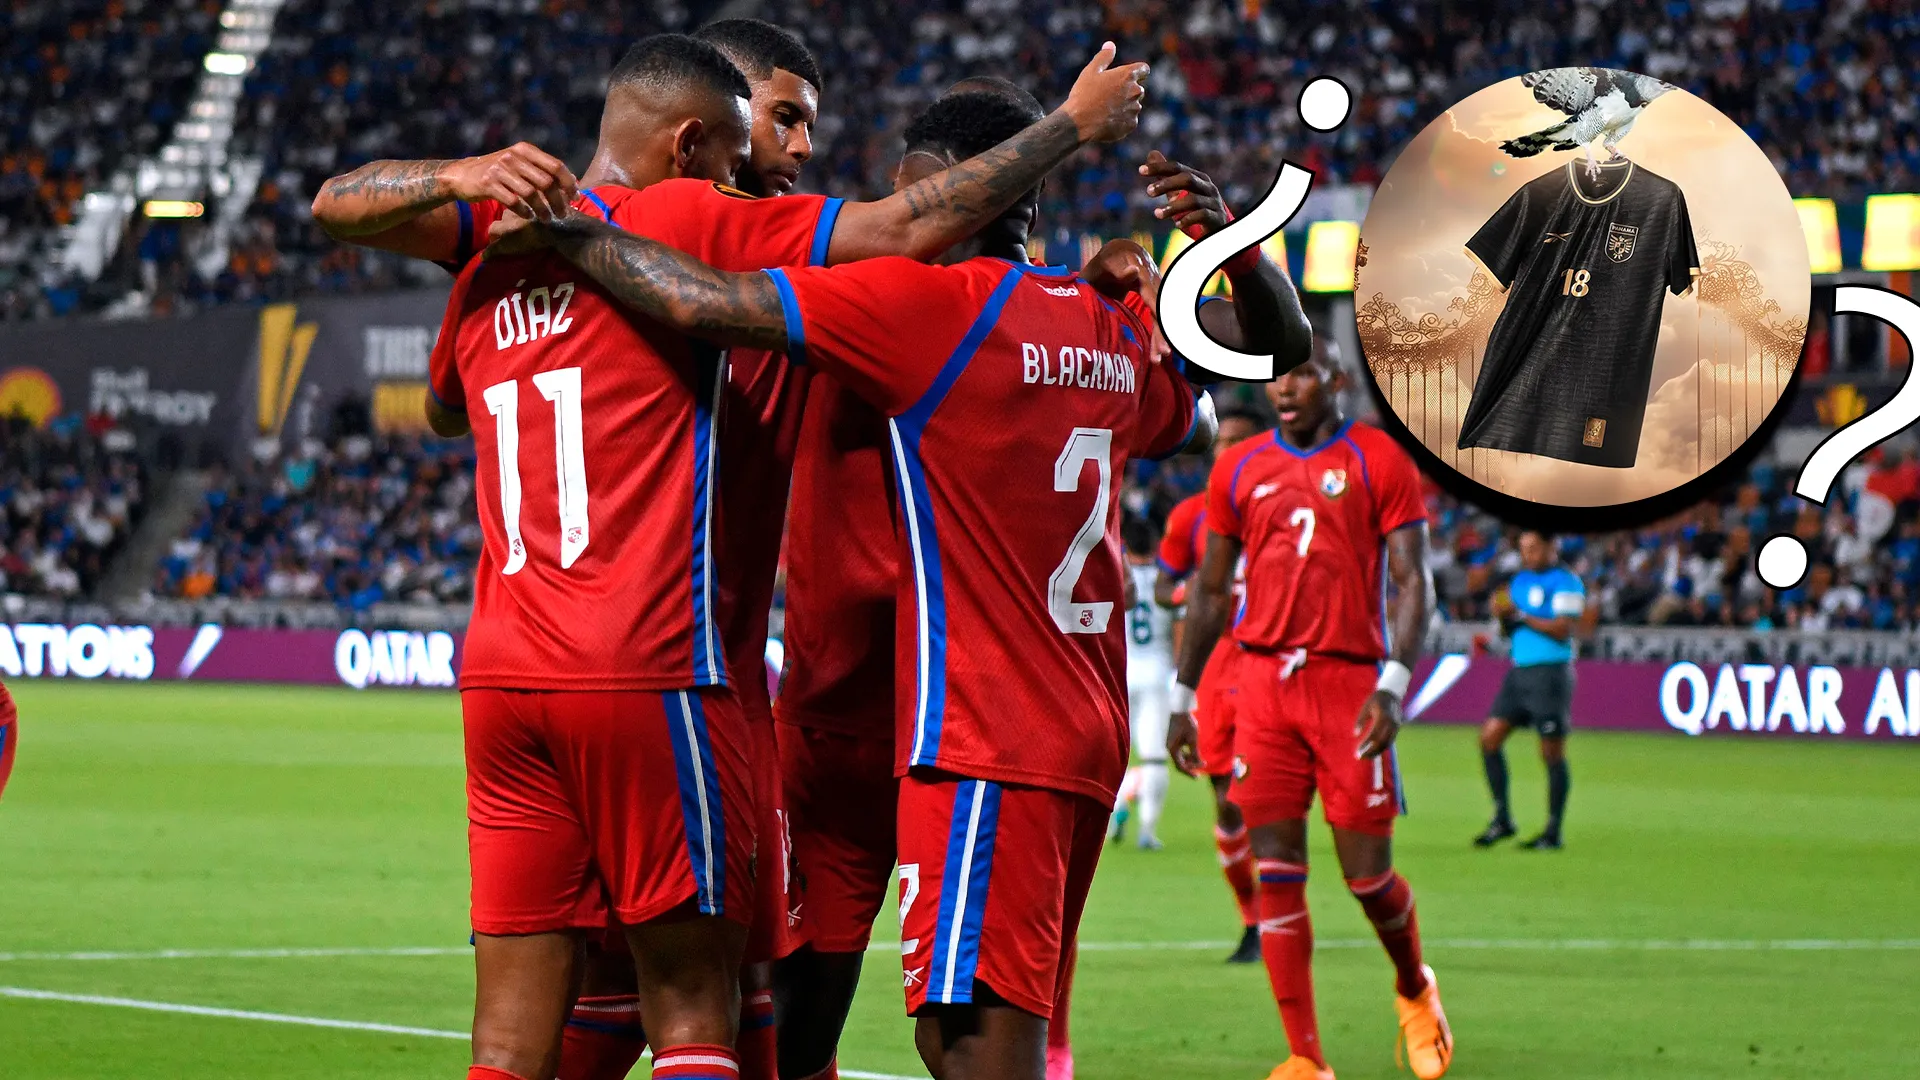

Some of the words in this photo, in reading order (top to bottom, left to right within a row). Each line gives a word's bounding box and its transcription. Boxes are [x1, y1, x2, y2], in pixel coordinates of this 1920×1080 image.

[495, 279, 574, 350] DÍAZ
[1561, 269, 1591, 297] 18
[1022, 342, 1135, 393] BLACKMAN
[483, 366, 589, 575] 11
[1048, 427, 1114, 634] 2
[335, 629, 455, 688] QATAR
[1660, 662, 1846, 735] QATAR
